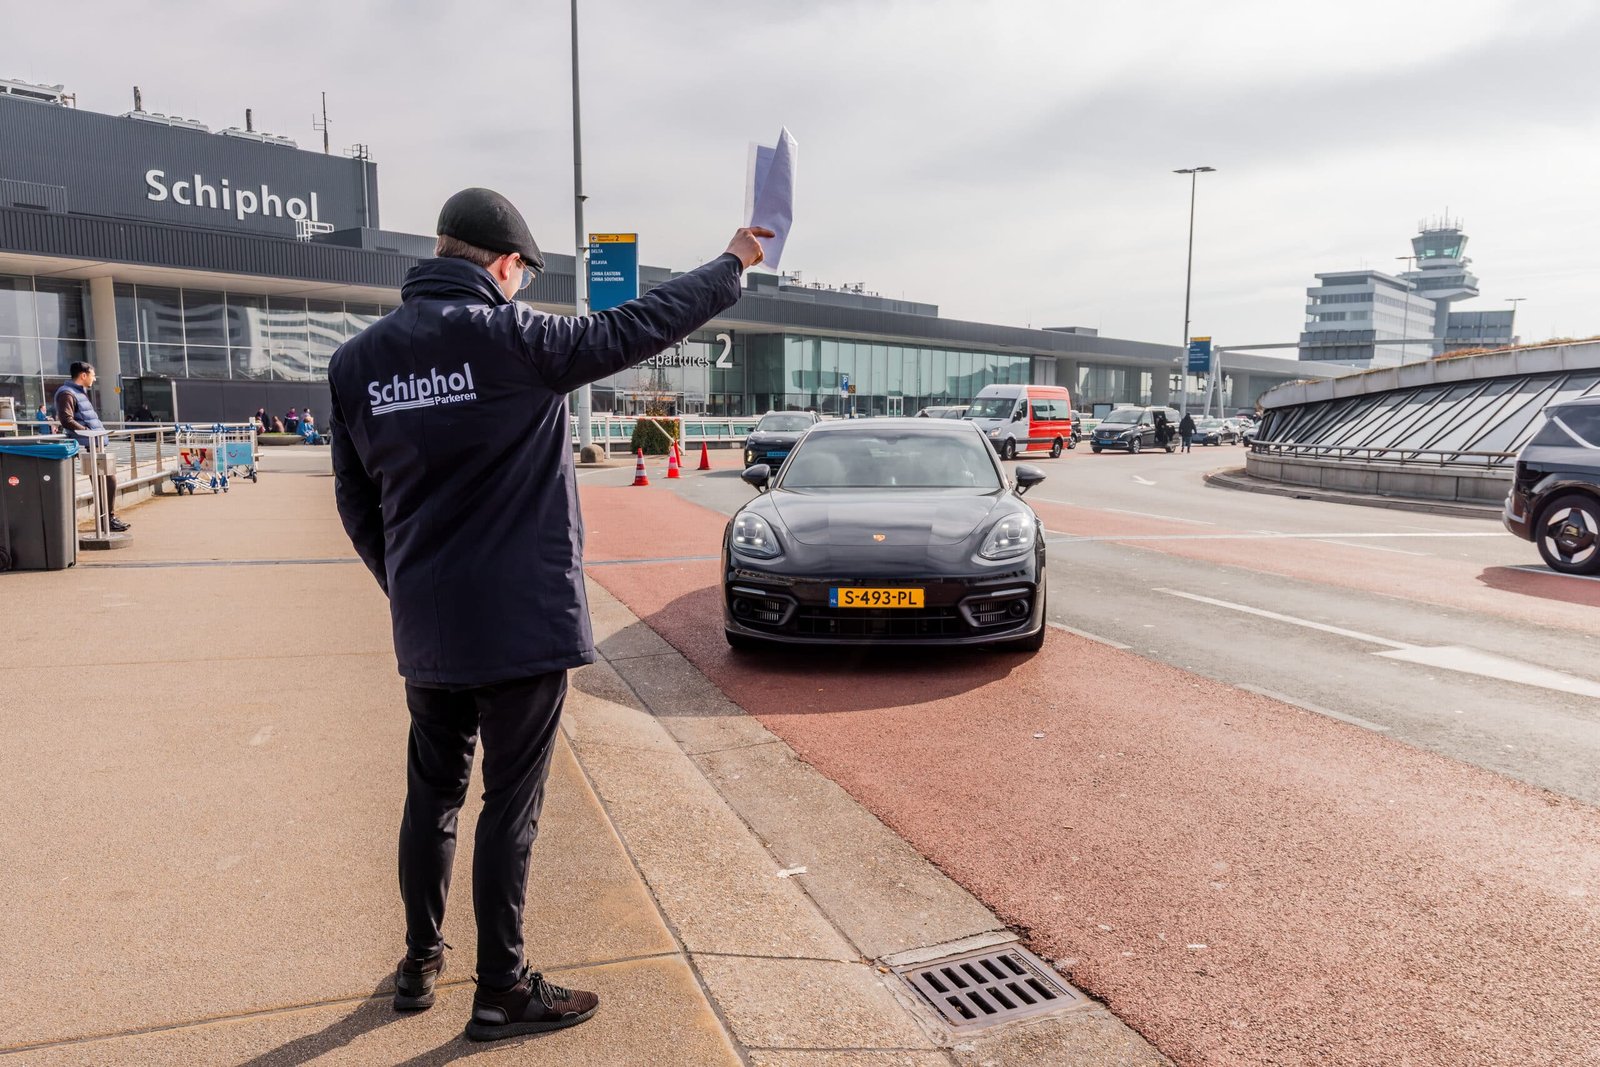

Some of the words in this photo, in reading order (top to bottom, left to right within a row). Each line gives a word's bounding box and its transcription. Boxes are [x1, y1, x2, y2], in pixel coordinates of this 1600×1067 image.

[145, 169, 319, 222] Schiphol
[639, 354, 710, 369] epartures
[715, 333, 733, 369] 2
[367, 362, 474, 406] Schiphol
[434, 392, 477, 405] Parkeren
[844, 590, 918, 606] S-493-PL
